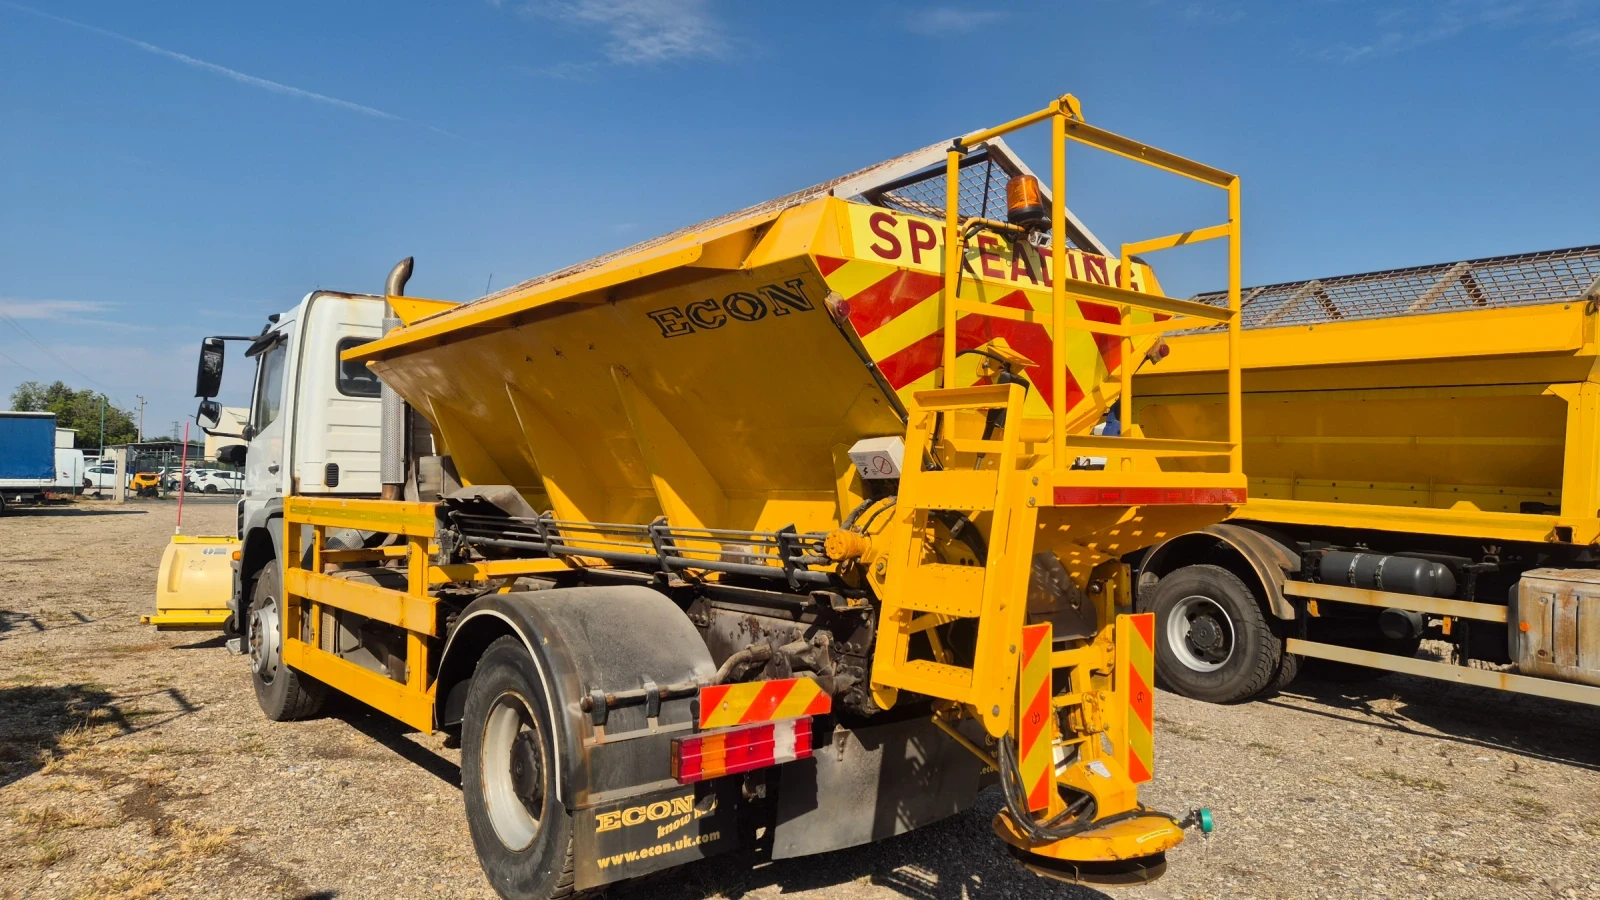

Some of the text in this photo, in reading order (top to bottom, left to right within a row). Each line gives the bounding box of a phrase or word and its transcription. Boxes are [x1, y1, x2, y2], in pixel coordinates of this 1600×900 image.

[646, 278, 815, 338] ECON
[596, 794, 695, 832] ECON
[657, 814, 691, 839] know
[598, 831, 720, 869] www.econ.uk.com
